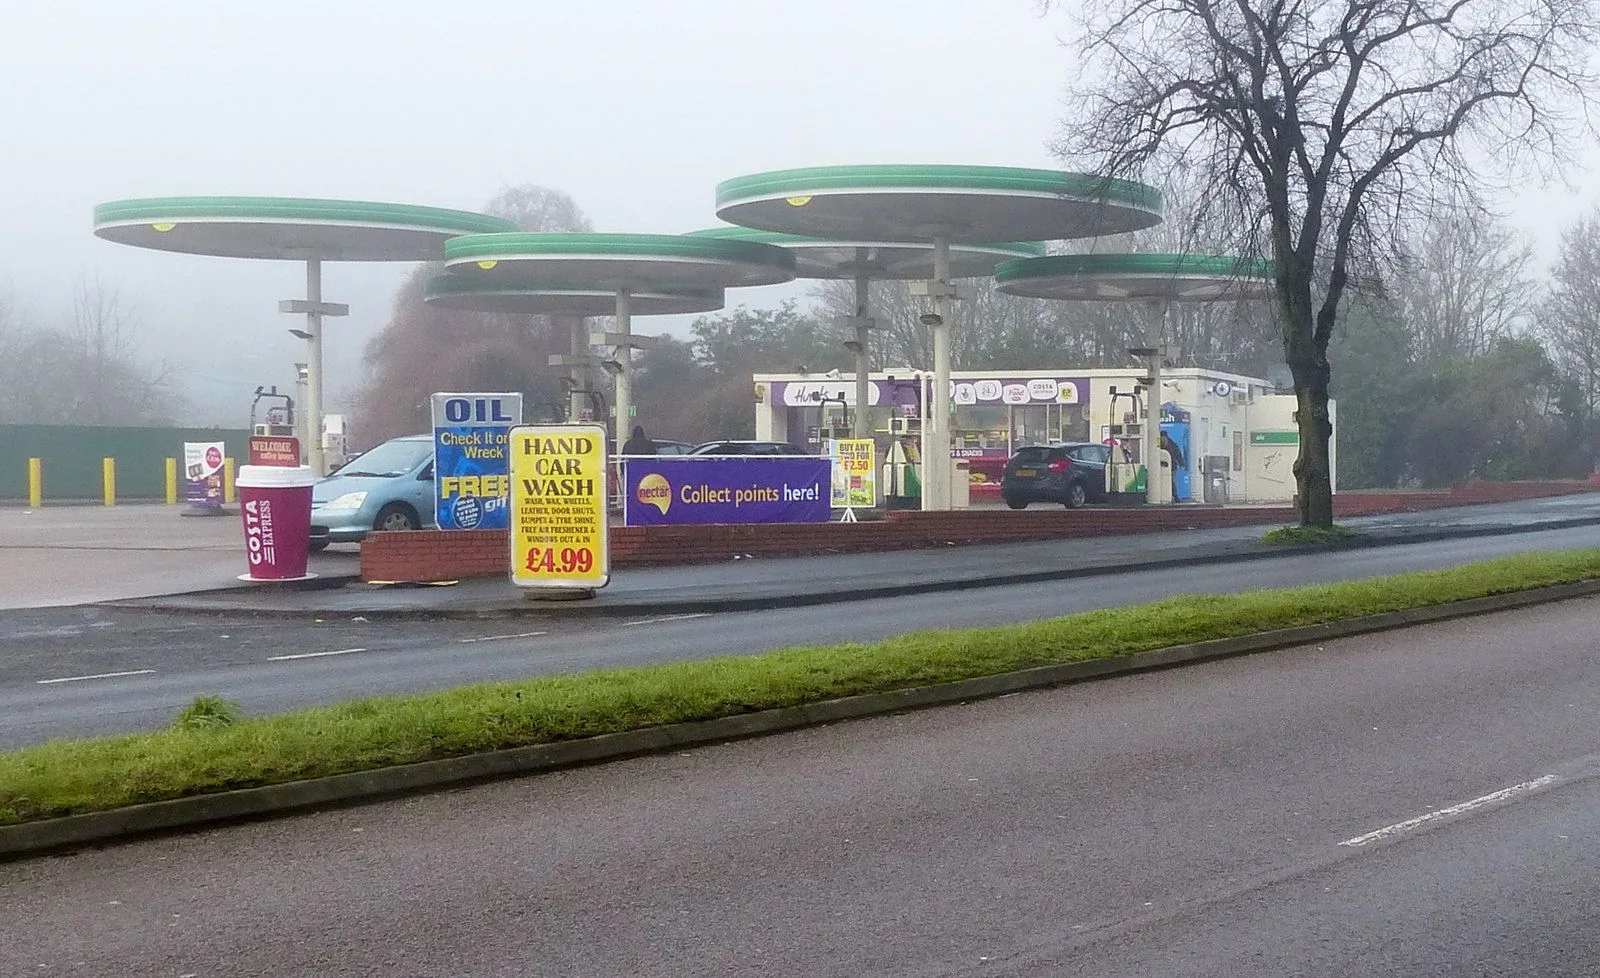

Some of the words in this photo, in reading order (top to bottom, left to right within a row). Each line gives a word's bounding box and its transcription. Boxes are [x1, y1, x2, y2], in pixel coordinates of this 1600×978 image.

[445, 399, 512, 422] OIL
[252, 441, 291, 452] WELCOME
[440, 432, 481, 445] Check
[485, 432, 493, 444] It
[524, 438, 592, 455] HAND
[464, 446, 503, 458] Wreck
[856, 452, 869, 460] FOR
[535, 458, 582, 475] CAR
[523, 479, 594, 496] WASH
[639, 486, 670, 498] nectar
[681, 485, 731, 504] Collect
[735, 484, 779, 507] points
[784, 483, 819, 501] here!
[260, 500, 274, 545] EXPRESS
[246, 501, 261, 564] COSTA
[525, 547, 593, 573] £4.99
